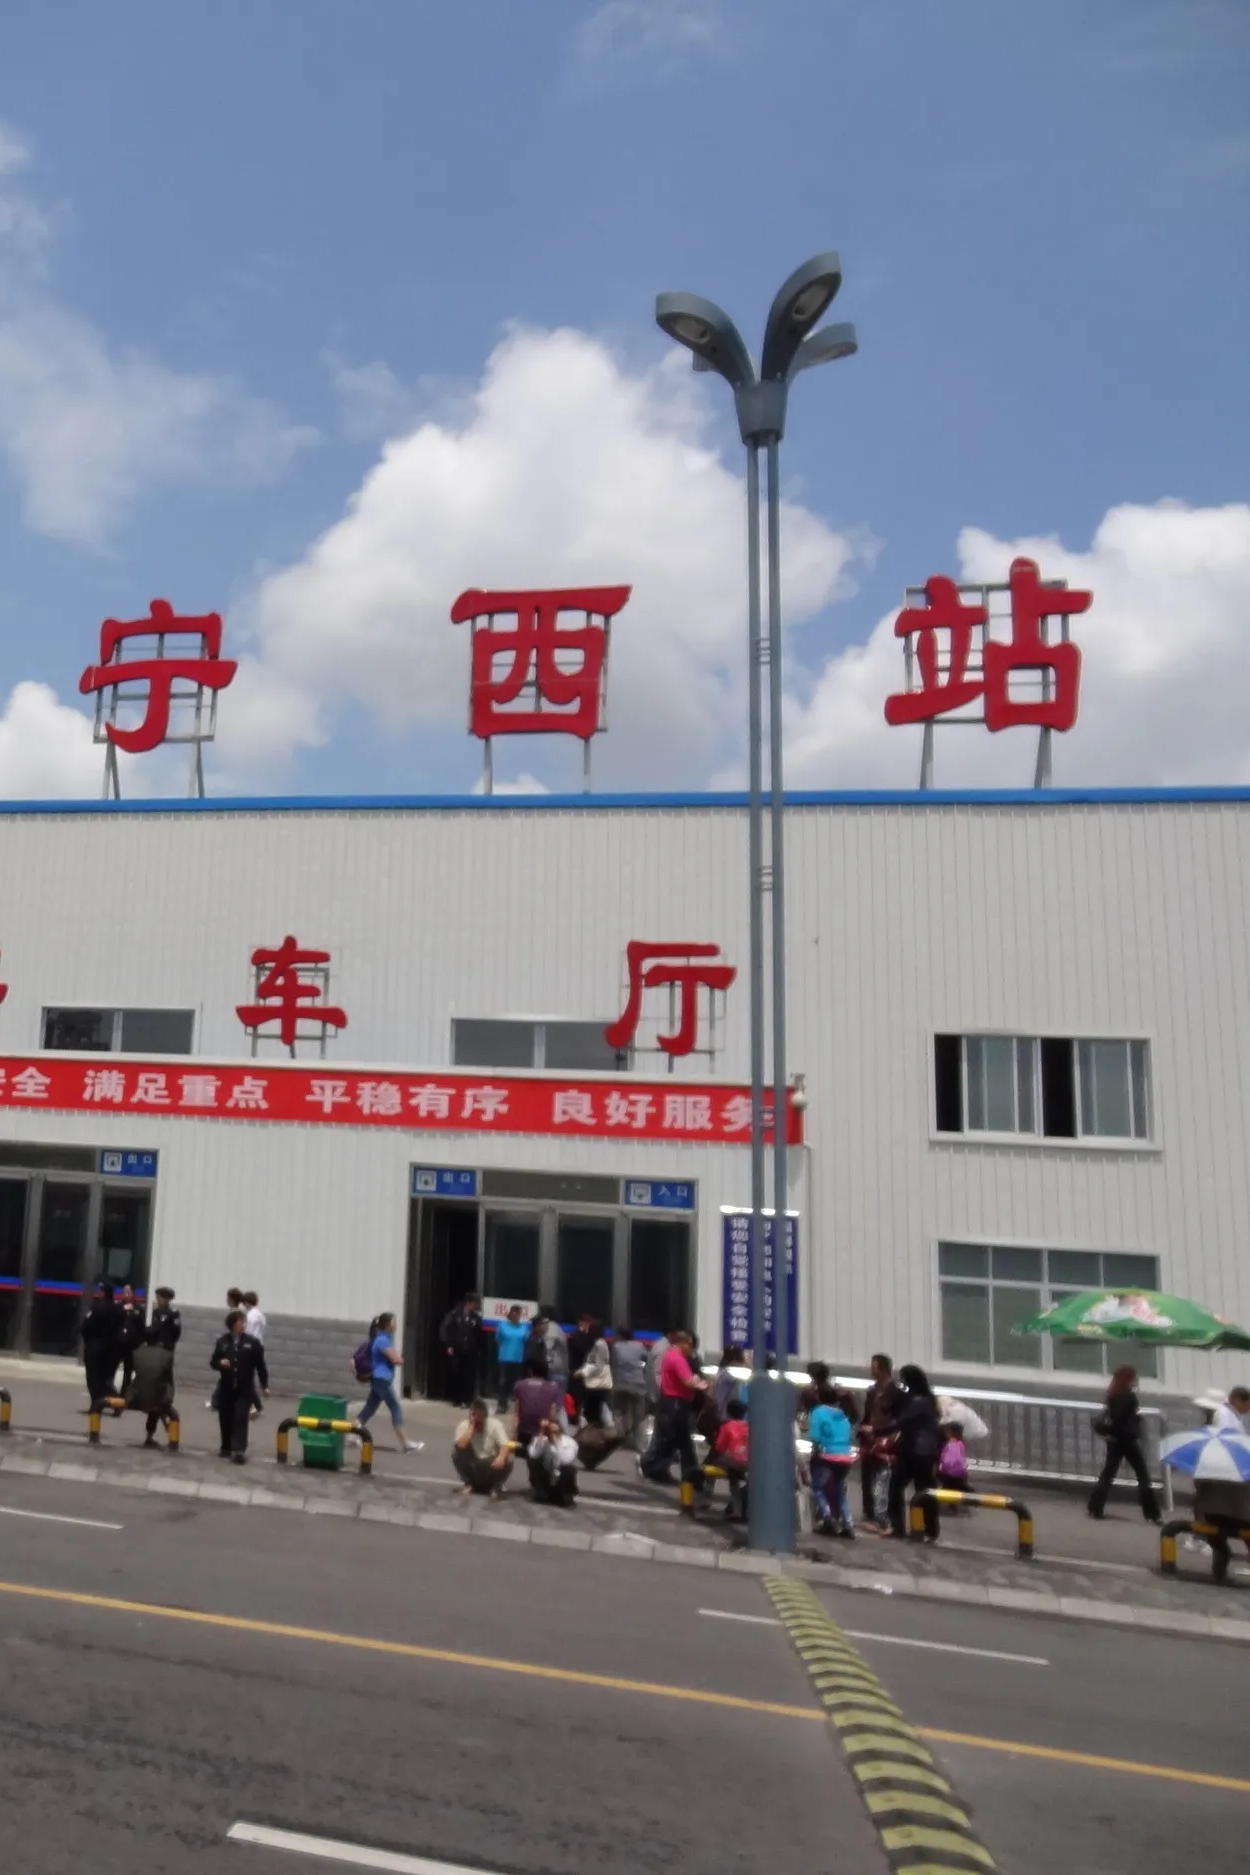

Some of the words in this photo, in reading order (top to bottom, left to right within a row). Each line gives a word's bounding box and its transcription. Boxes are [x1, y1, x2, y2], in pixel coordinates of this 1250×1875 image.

[82, 1068, 269, 1110] 满足重点
[305, 1078, 510, 1121] 平稳有序
